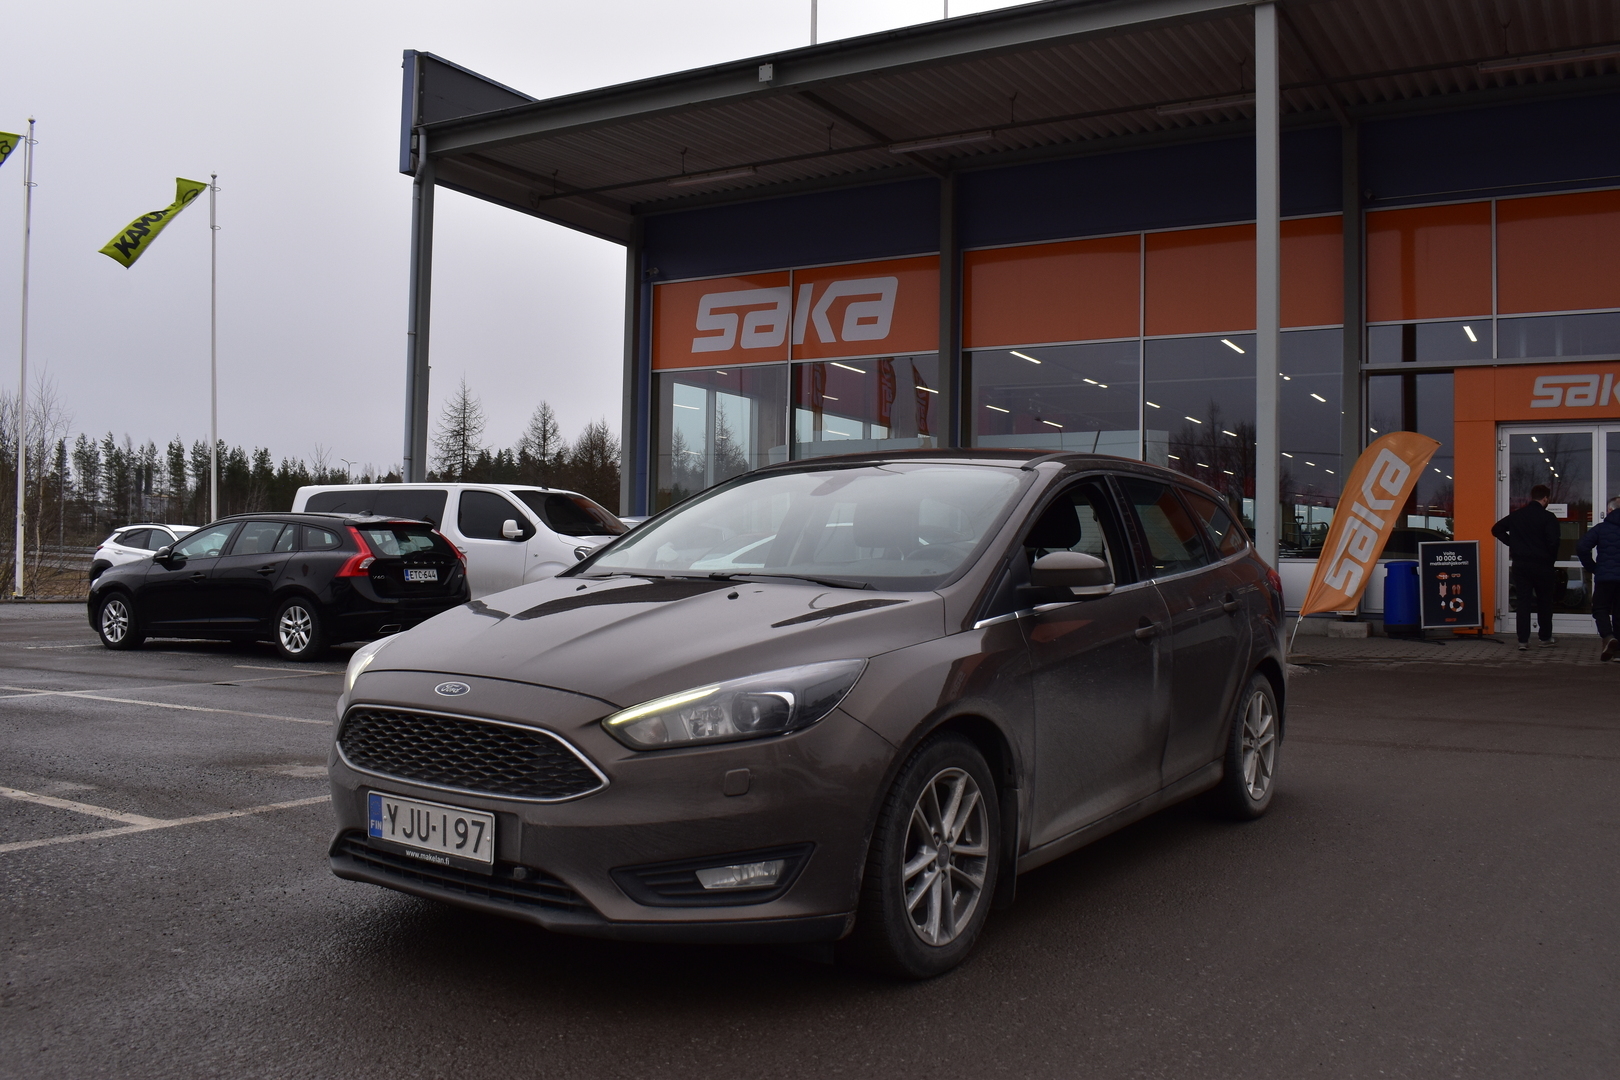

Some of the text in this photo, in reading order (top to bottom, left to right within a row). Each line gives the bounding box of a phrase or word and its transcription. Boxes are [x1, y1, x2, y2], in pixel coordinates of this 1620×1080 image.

[370, 819, 382, 831] FIN
[386, 803, 486, 853] YJU-197
[405, 849, 450, 866] www.makelan.fi
